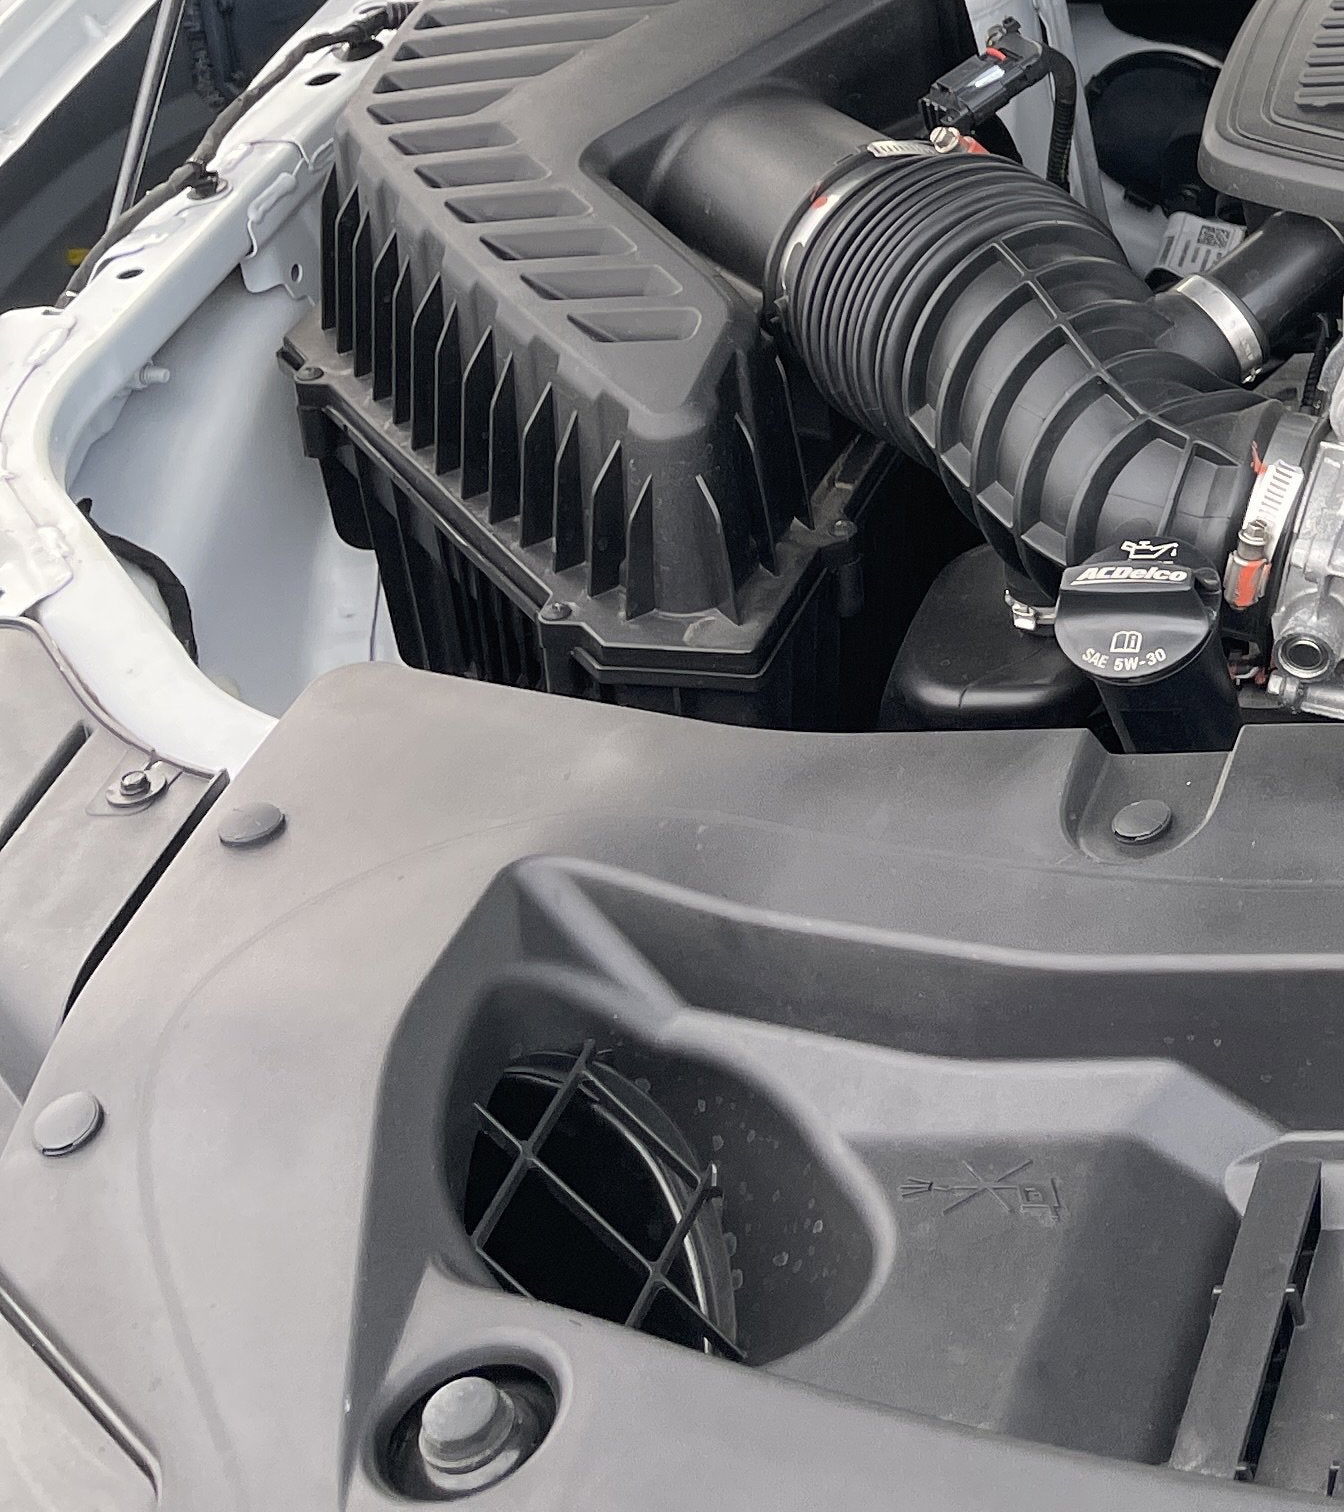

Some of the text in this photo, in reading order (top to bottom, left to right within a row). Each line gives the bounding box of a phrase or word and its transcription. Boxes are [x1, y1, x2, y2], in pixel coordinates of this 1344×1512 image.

[1076, 566, 1188, 581] ACDelco
[1082, 648, 1167, 672] SAE 5W-30
